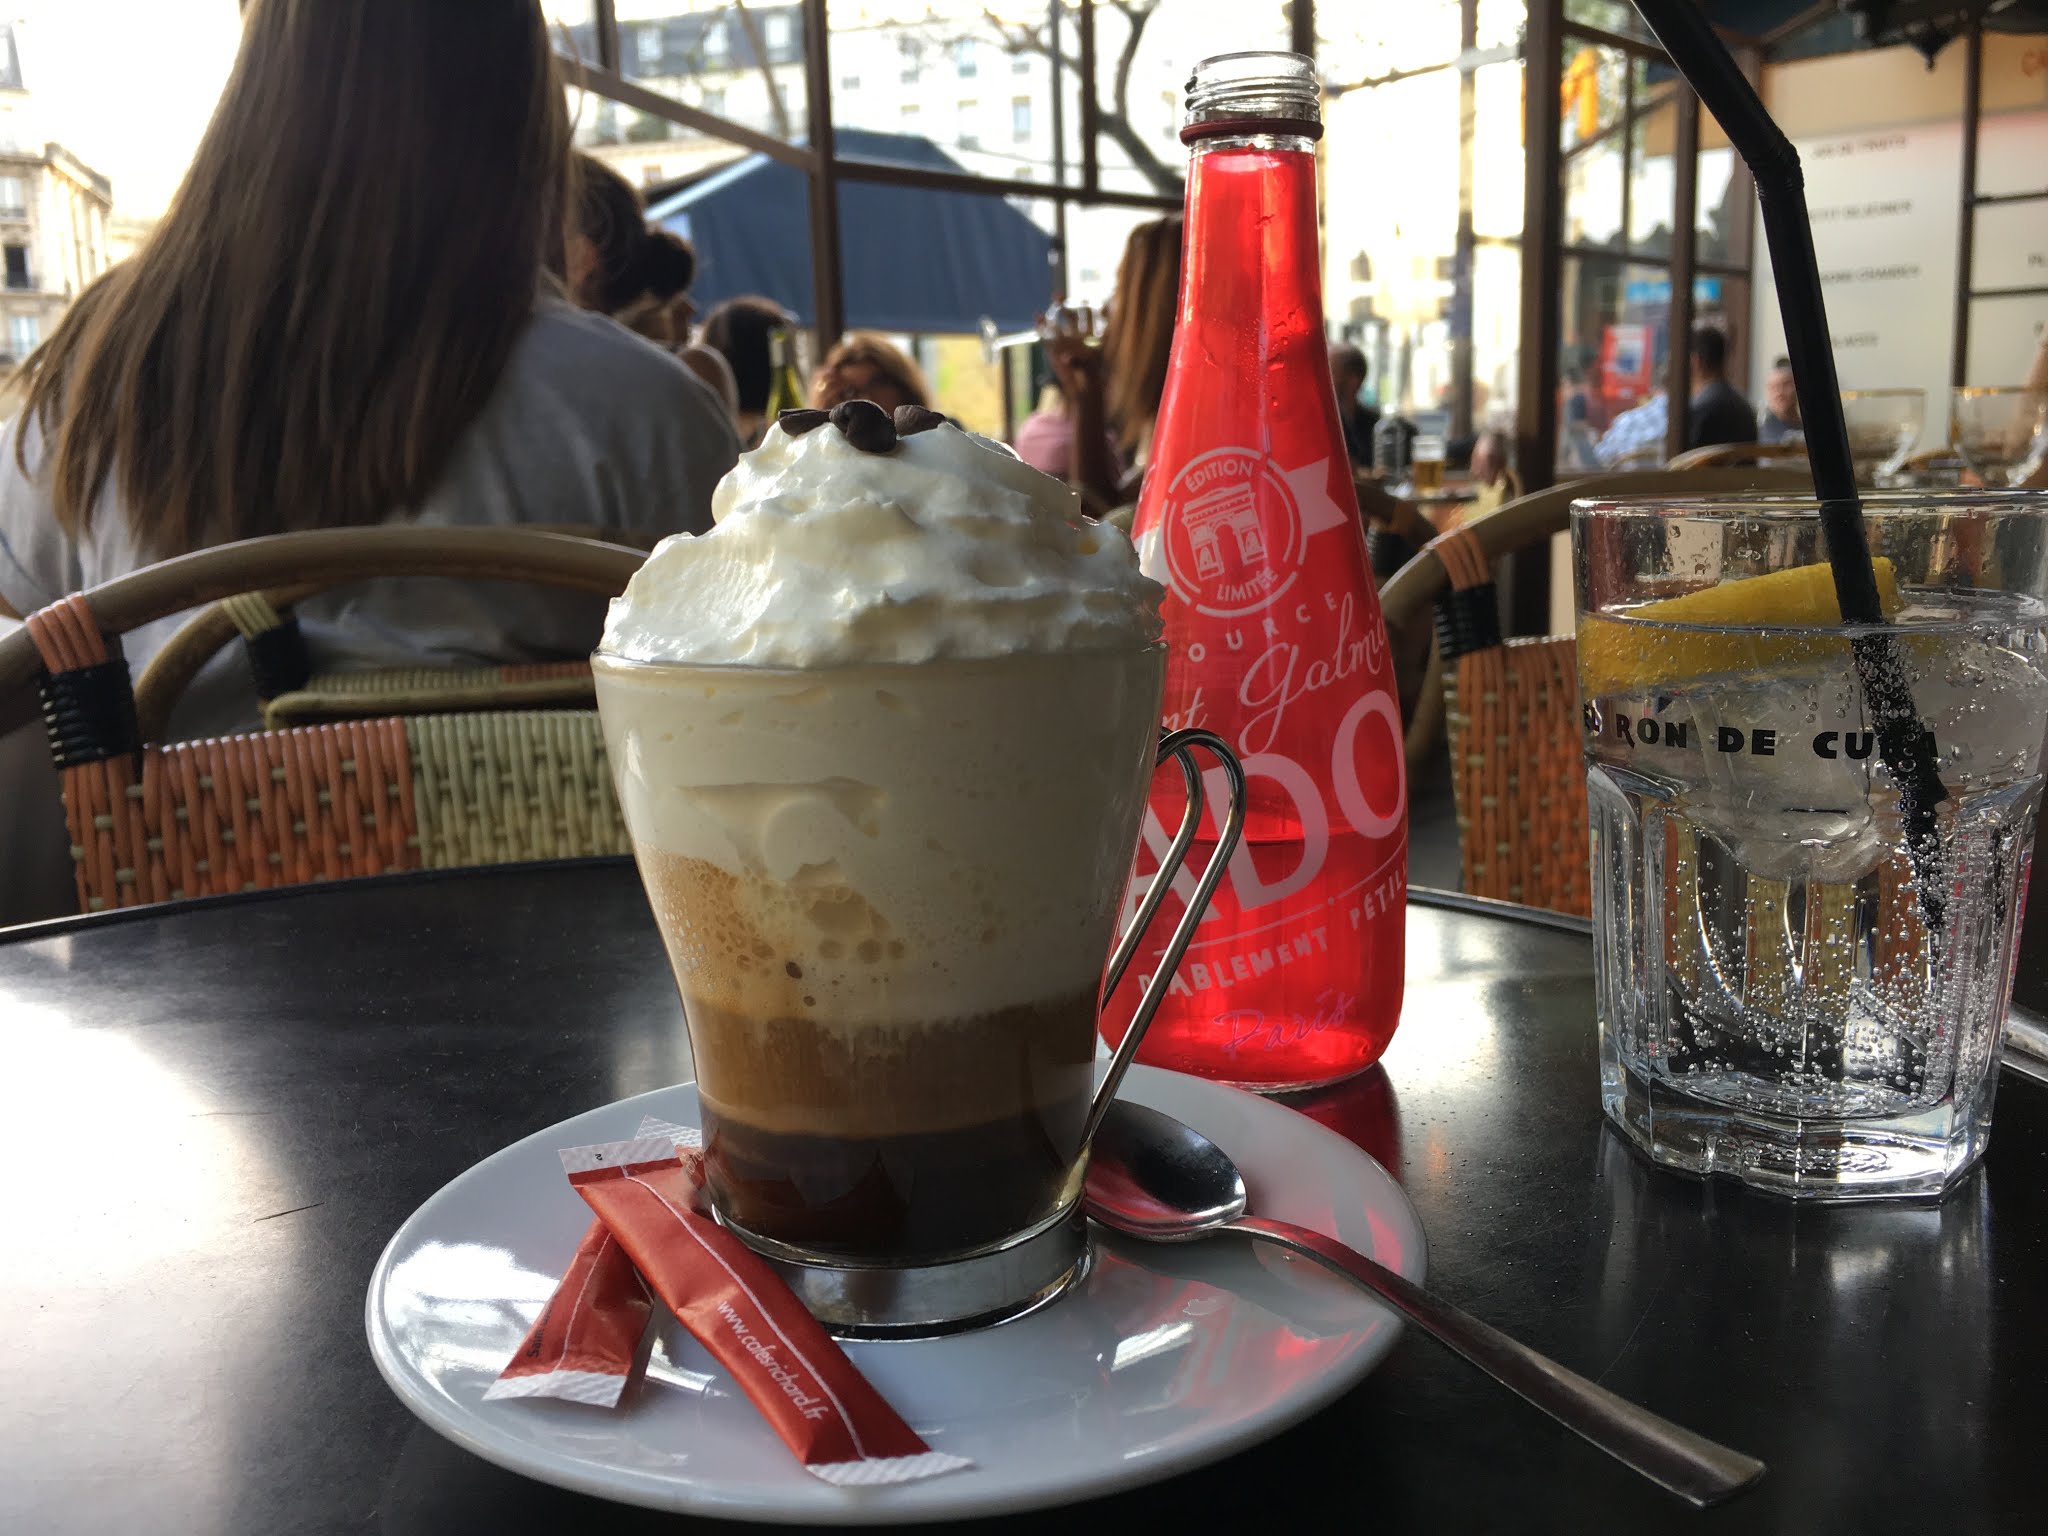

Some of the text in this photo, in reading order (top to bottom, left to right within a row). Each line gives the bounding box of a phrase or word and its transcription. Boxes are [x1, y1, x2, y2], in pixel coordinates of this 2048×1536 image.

[1185, 458, 1254, 493] ÉDITION
[1217, 566, 1278, 602] LIMITÉE
[1187, 591, 1337, 662] OURCE
[1615, 713, 1687, 749] RON
[1718, 726, 1776, 756] DE
[1812, 731, 1939, 760] CU
[1119, 689, 1407, 939] ADO
[1138, 926, 1328, 999] DABLEMENT
[1213, 987, 1355, 1061] Paris
[717, 1300, 829, 1420] www.cafesrichard.fr
